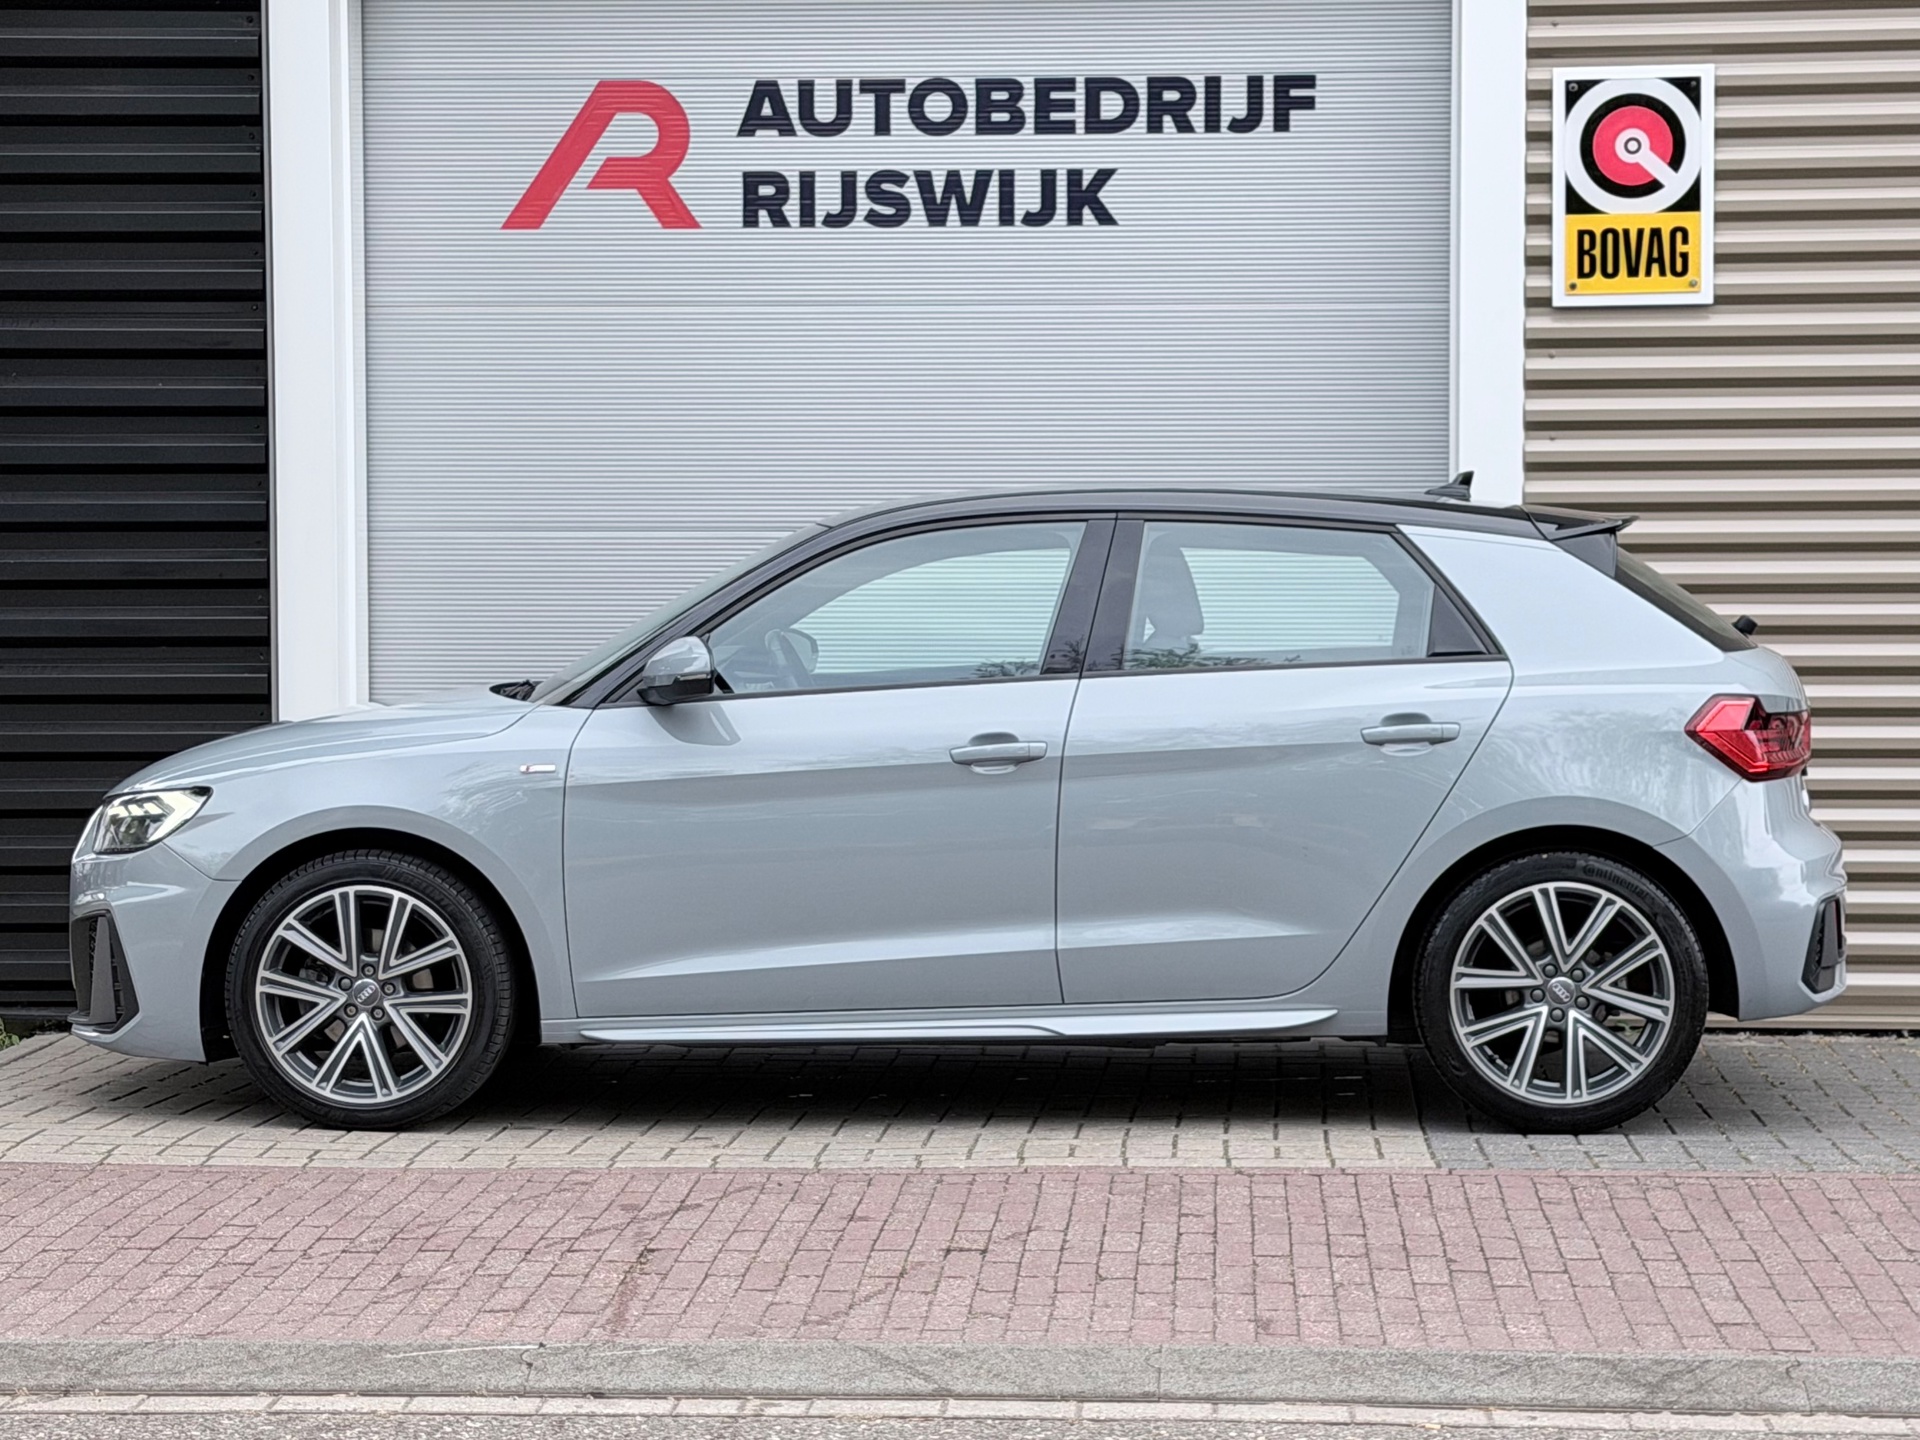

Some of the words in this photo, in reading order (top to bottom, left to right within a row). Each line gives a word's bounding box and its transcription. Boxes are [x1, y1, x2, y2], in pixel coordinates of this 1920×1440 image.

[737, 74, 1316, 138] AUTOBEDRIJF
[742, 168, 1119, 229] RIJSWIJK
[1577, 226, 1690, 279] BOVAG
